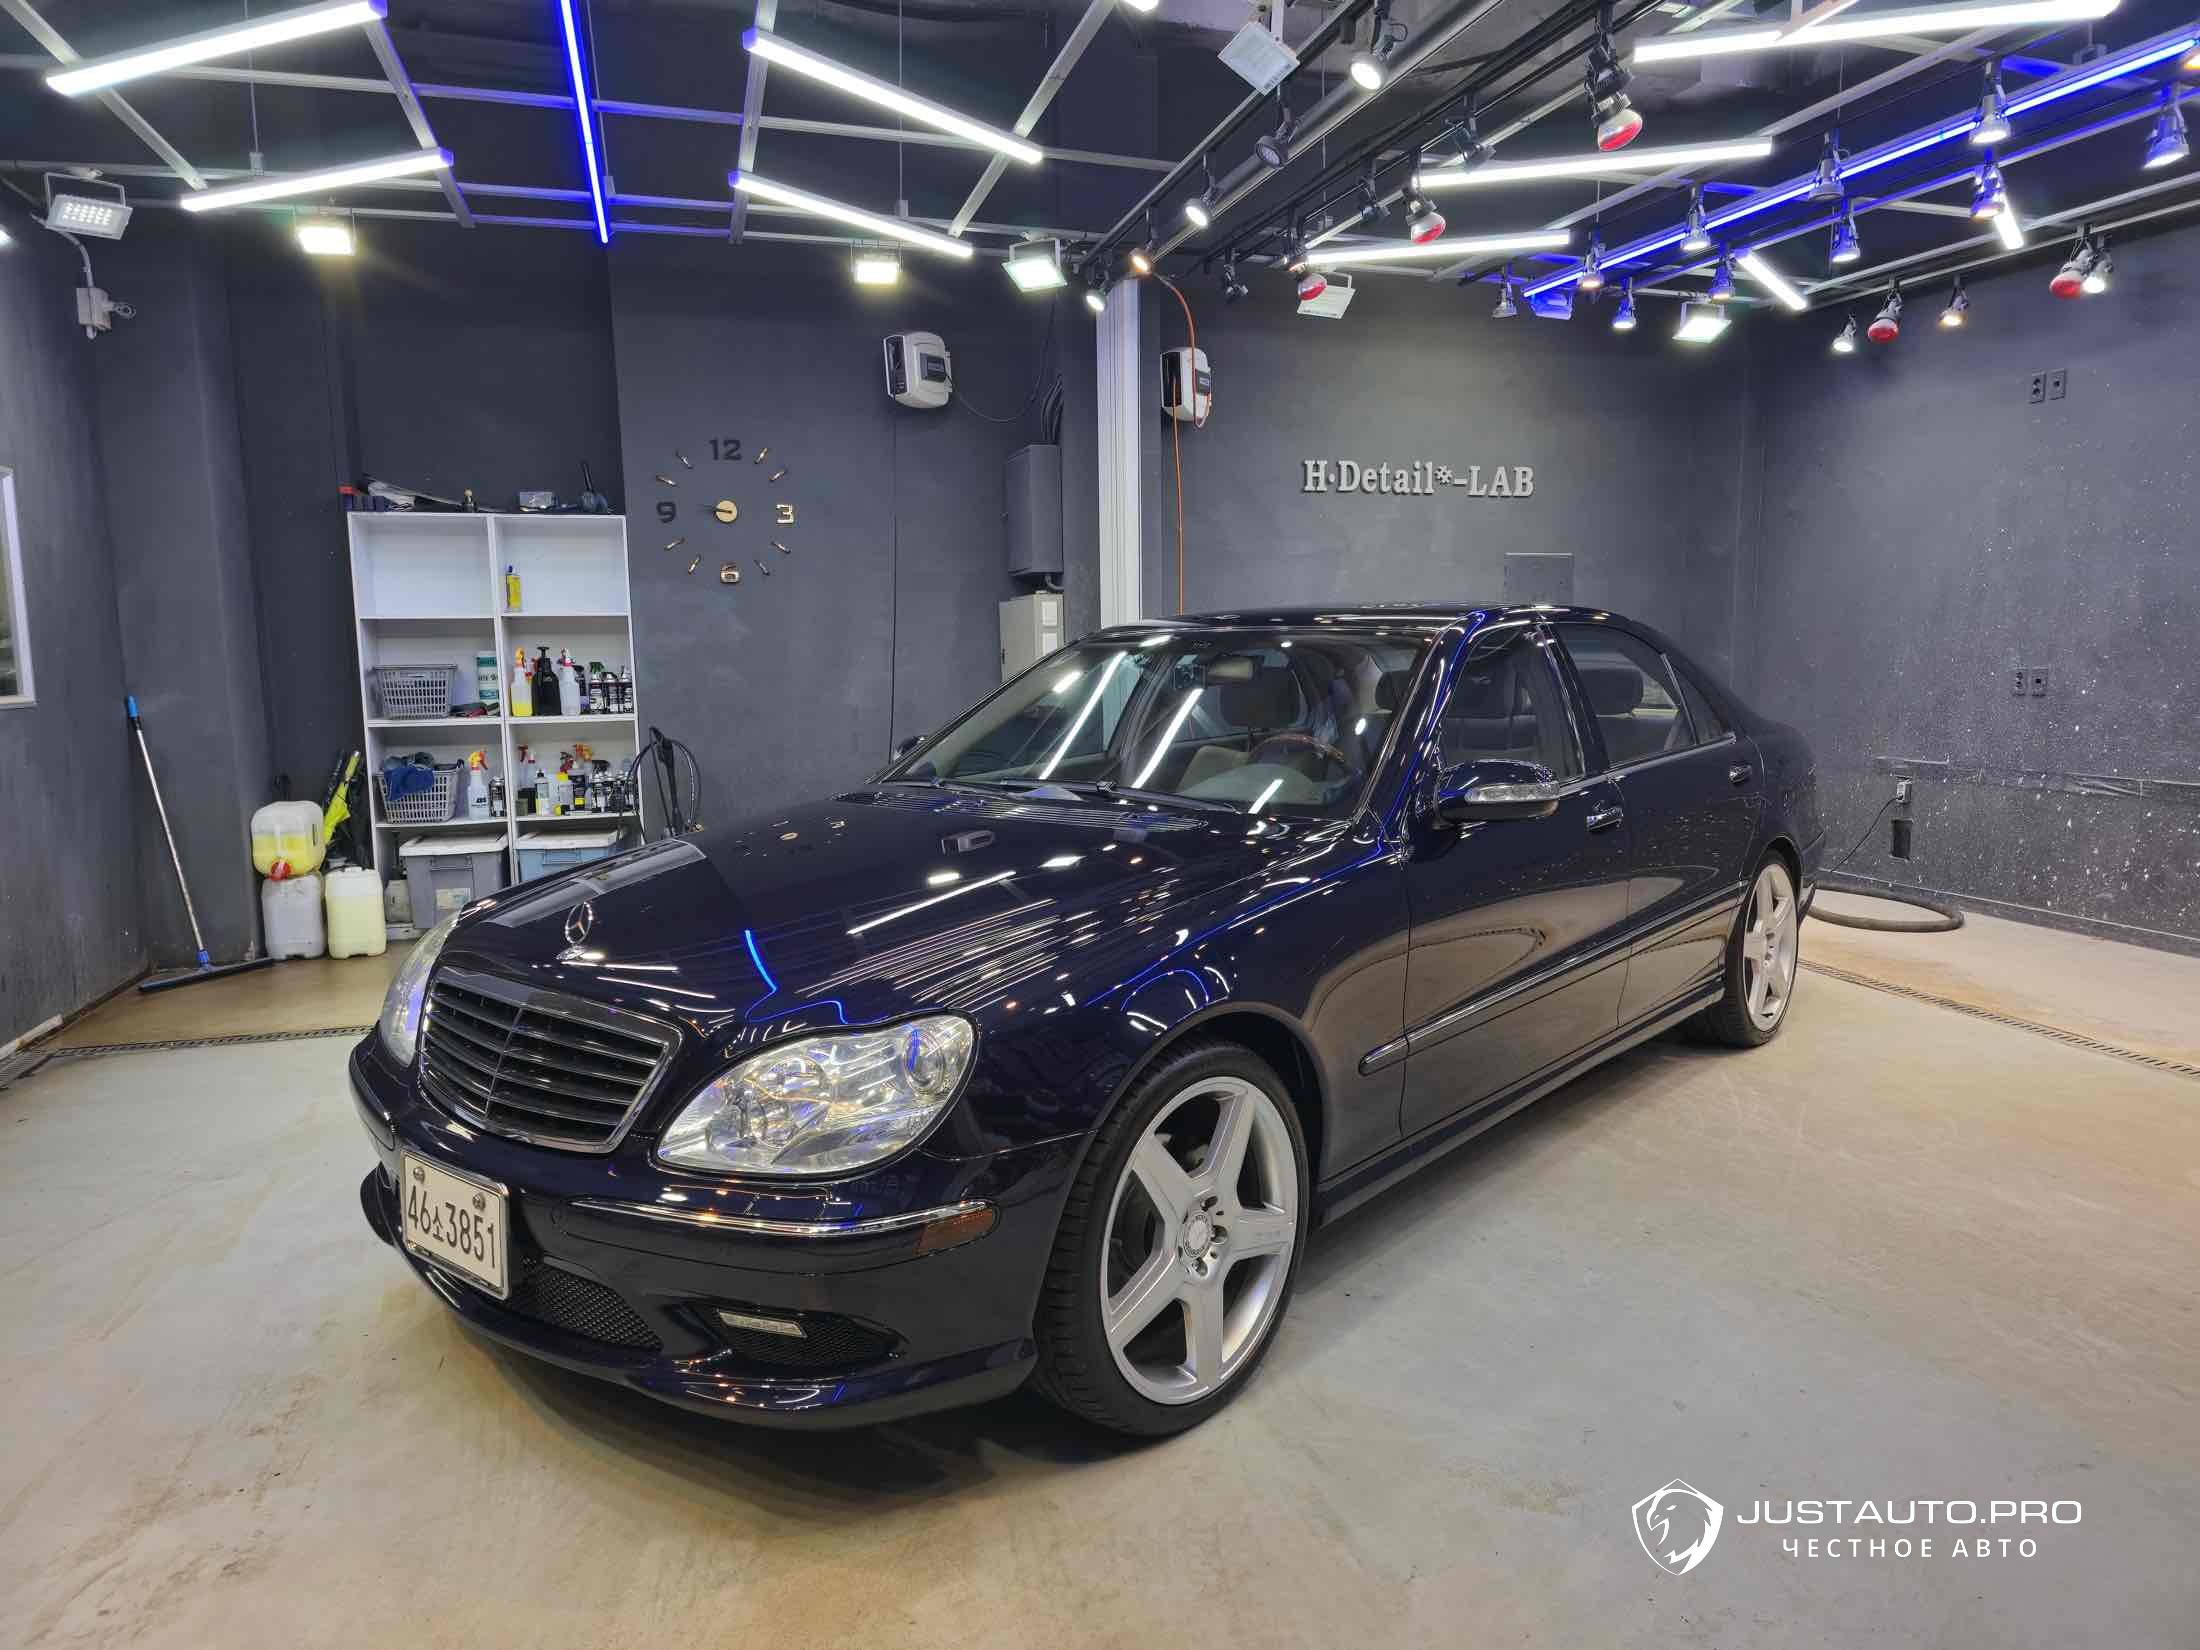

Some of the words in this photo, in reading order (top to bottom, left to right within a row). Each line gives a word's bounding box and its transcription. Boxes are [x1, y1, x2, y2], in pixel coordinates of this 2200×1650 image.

[709, 439, 742, 461] 12
[656, 501, 677, 523] 9
[775, 503, 795, 525] 3
[719, 560, 741, 584] 6
[407, 1184, 497, 1269] 46소3851
